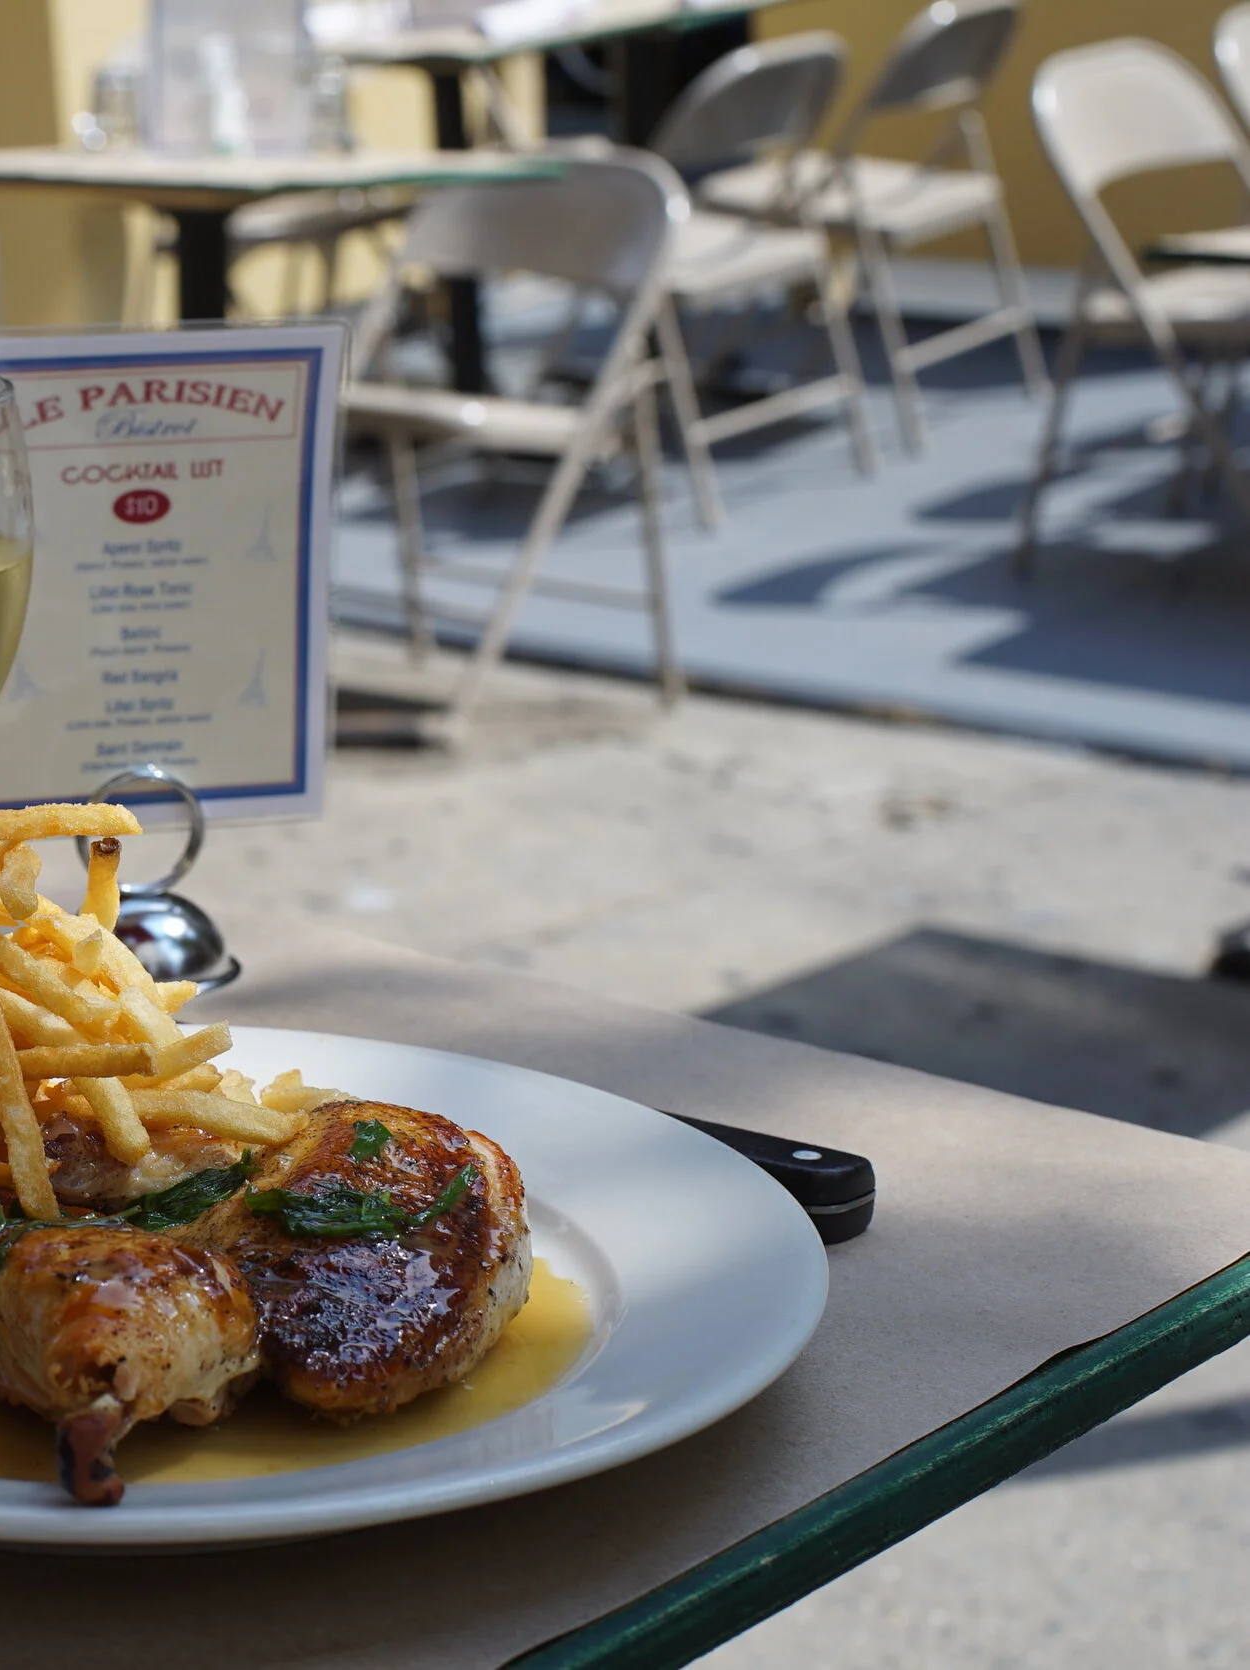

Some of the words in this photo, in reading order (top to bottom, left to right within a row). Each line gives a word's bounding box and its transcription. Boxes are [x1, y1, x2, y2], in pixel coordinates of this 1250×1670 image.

[79, 378, 285, 423] PARISIEN
[61, 460, 178, 485] COCKTAIL
[190, 459, 224, 479] LIST
[124, 496, 158, 517] $10
